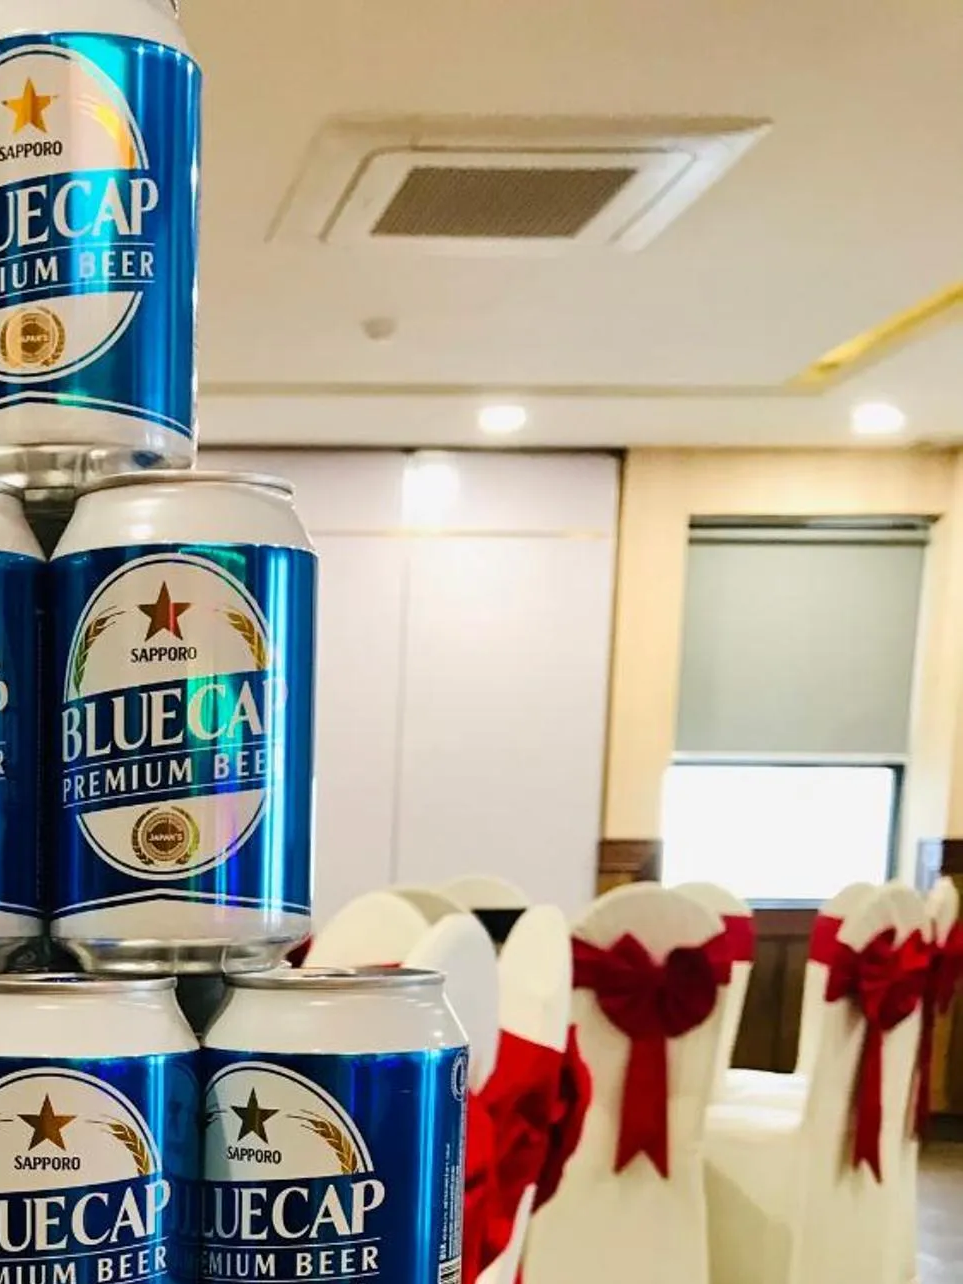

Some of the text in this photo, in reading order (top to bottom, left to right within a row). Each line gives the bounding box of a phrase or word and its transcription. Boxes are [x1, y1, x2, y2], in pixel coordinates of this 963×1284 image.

[80, 251, 154, 281] BEER
[18, 333, 50, 343] APAN'S
[130, 646, 197, 663] SAPPORO
[63, 750, 275, 801] PREMIUM BEE
[14, 1155, 80, 1171] SAPPORO
[226, 1145, 282, 1164] SAPPORO
[201, 1178, 385, 1241] LUECAP
[98, 1246, 166, 1282] BEER
[296, 1246, 379, 1277] BEER
